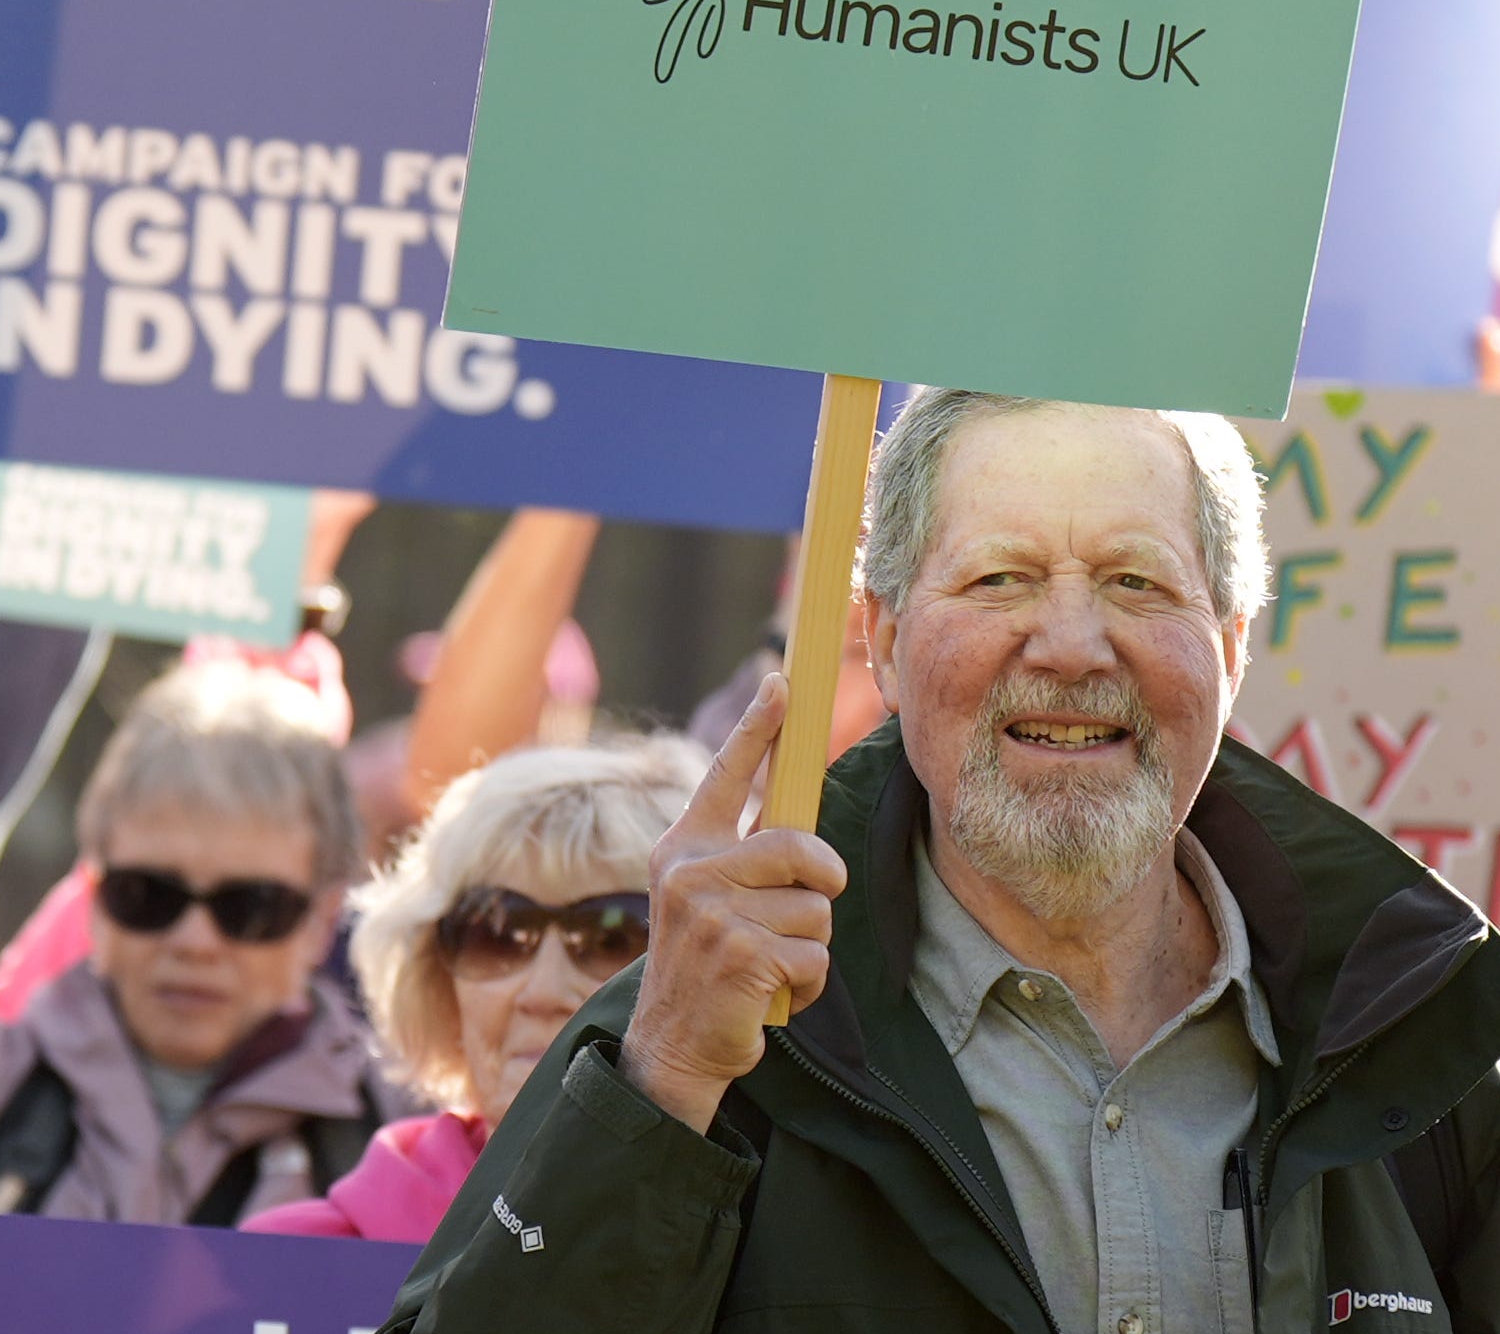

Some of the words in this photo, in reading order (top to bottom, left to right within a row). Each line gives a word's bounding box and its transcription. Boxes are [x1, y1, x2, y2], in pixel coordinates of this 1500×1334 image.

[1116, 17, 1207, 88] UK
[100, 285, 556, 420] DYING.
[1352, 1290, 1434, 1315] berghaus
